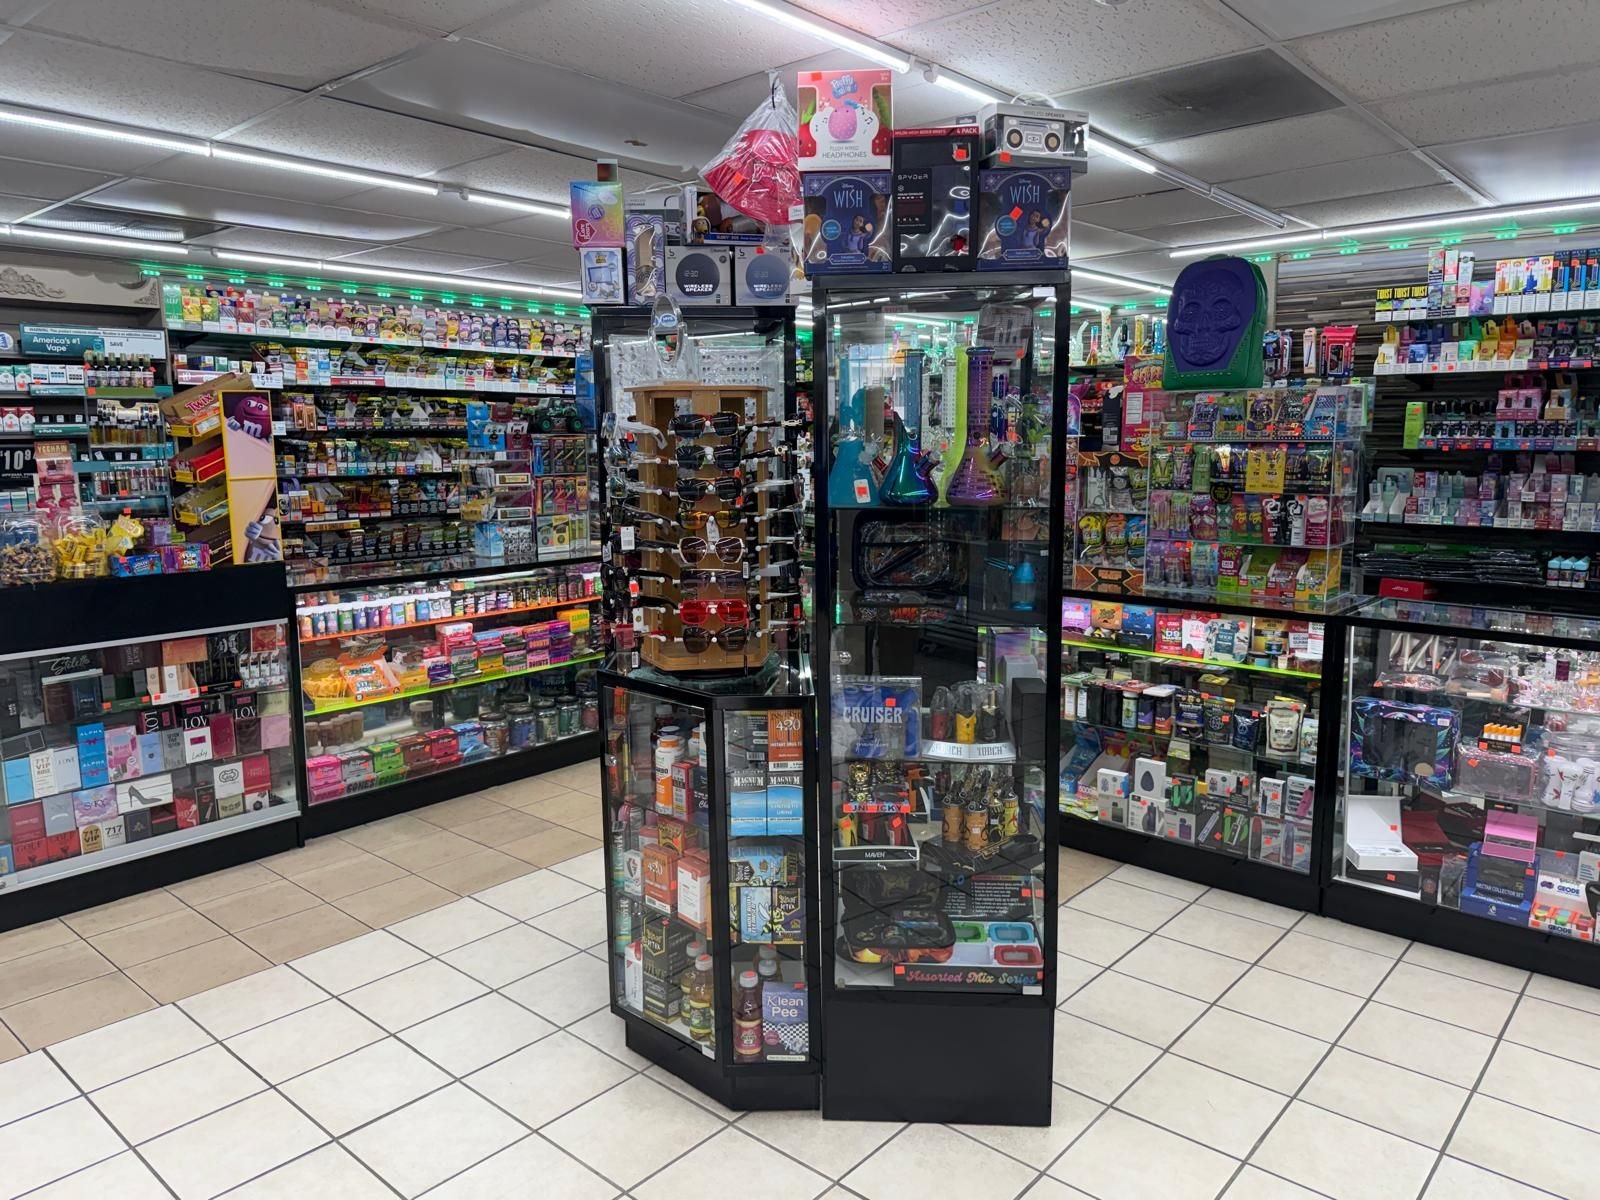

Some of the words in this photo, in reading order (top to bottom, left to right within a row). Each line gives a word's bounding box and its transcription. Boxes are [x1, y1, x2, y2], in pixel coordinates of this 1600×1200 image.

[833, 189, 863, 208] WISH
[1010, 184, 1040, 204] WISH
[33, 335, 70, 345] America's
[72, 337, 81, 345] #1
[46, 344, 67, 352] Vape
[187, 392, 214, 413] Twix
[842, 706, 903, 724] CRUISER
[776, 719, 801, 731] 420
[734, 776, 764, 787] MAGNUM
[769, 776, 800, 785] MAGNUM
[105, 825, 123, 835] 717
[83, 834, 100, 843] VIP
[1475, 882, 1492, 891] NECTAR
[1491, 885, 1516, 897] COLLECTOR
[1557, 885, 1580, 895] GEODE
[1548, 924, 1572, 934] GEODE
[906, 970, 963, 983] Assorted
[966, 971, 995, 984] Mix
[998, 972, 1035, 984] Series
[767, 995, 804, 1007] Klean
[771, 1006, 798, 1017] Pee
